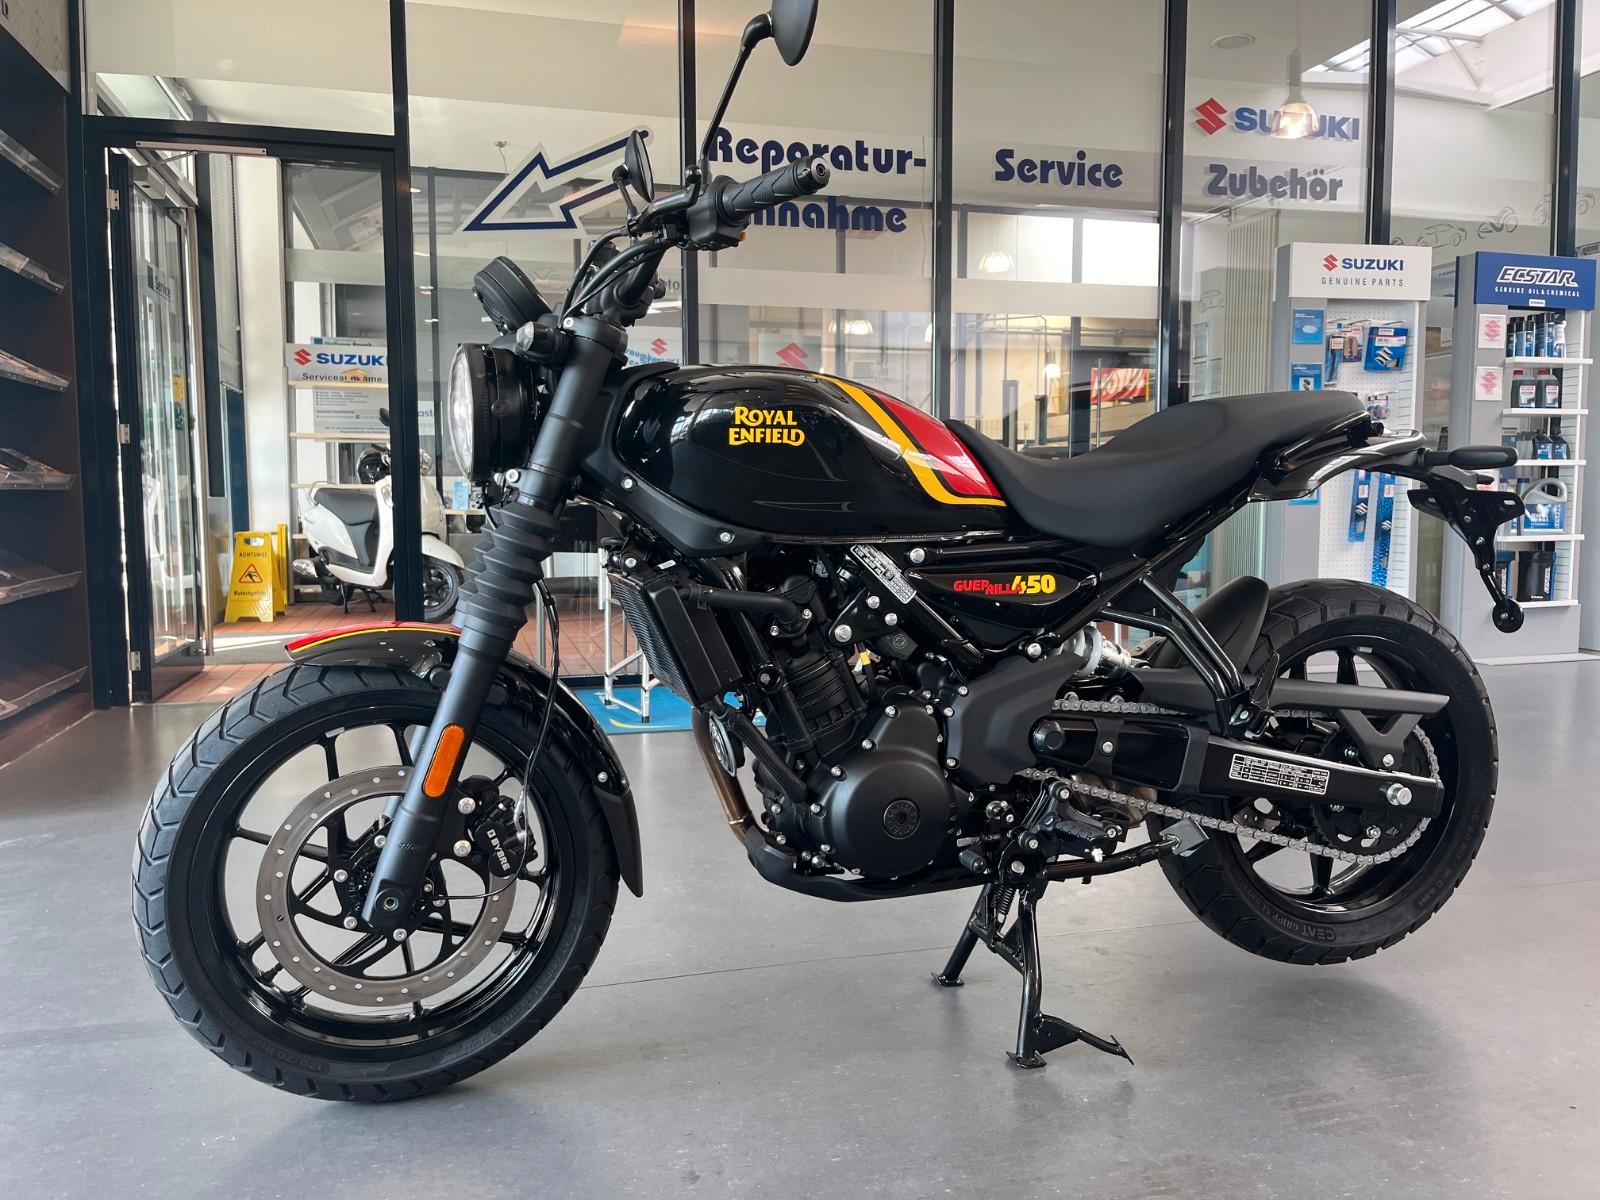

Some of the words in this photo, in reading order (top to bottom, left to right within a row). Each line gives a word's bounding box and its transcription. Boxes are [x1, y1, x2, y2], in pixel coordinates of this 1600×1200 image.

[708, 126, 926, 174] Reparatur-
[995, 148, 1123, 188] Service
[1207, 163, 1343, 200] Zubehör
[754, 196, 907, 232] nnahme
[1342, 257, 1404, 271] SUZUKI
[1321, 277, 1367, 286] GENUINE
[1371, 278, 1404, 287] PARTS
[1496, 265, 1579, 287] ECSTAR
[1495, 286, 1524, 294] GENUINE
[316, 352, 385, 366] SUZUK
[734, 406, 797, 426] ROYAL
[728, 427, 805, 447] ENFIELD
[953, 580, 1021, 595] GUERRILLA
[1011, 574, 1056, 594] 450
[1301, 924, 1336, 942] CEAT
